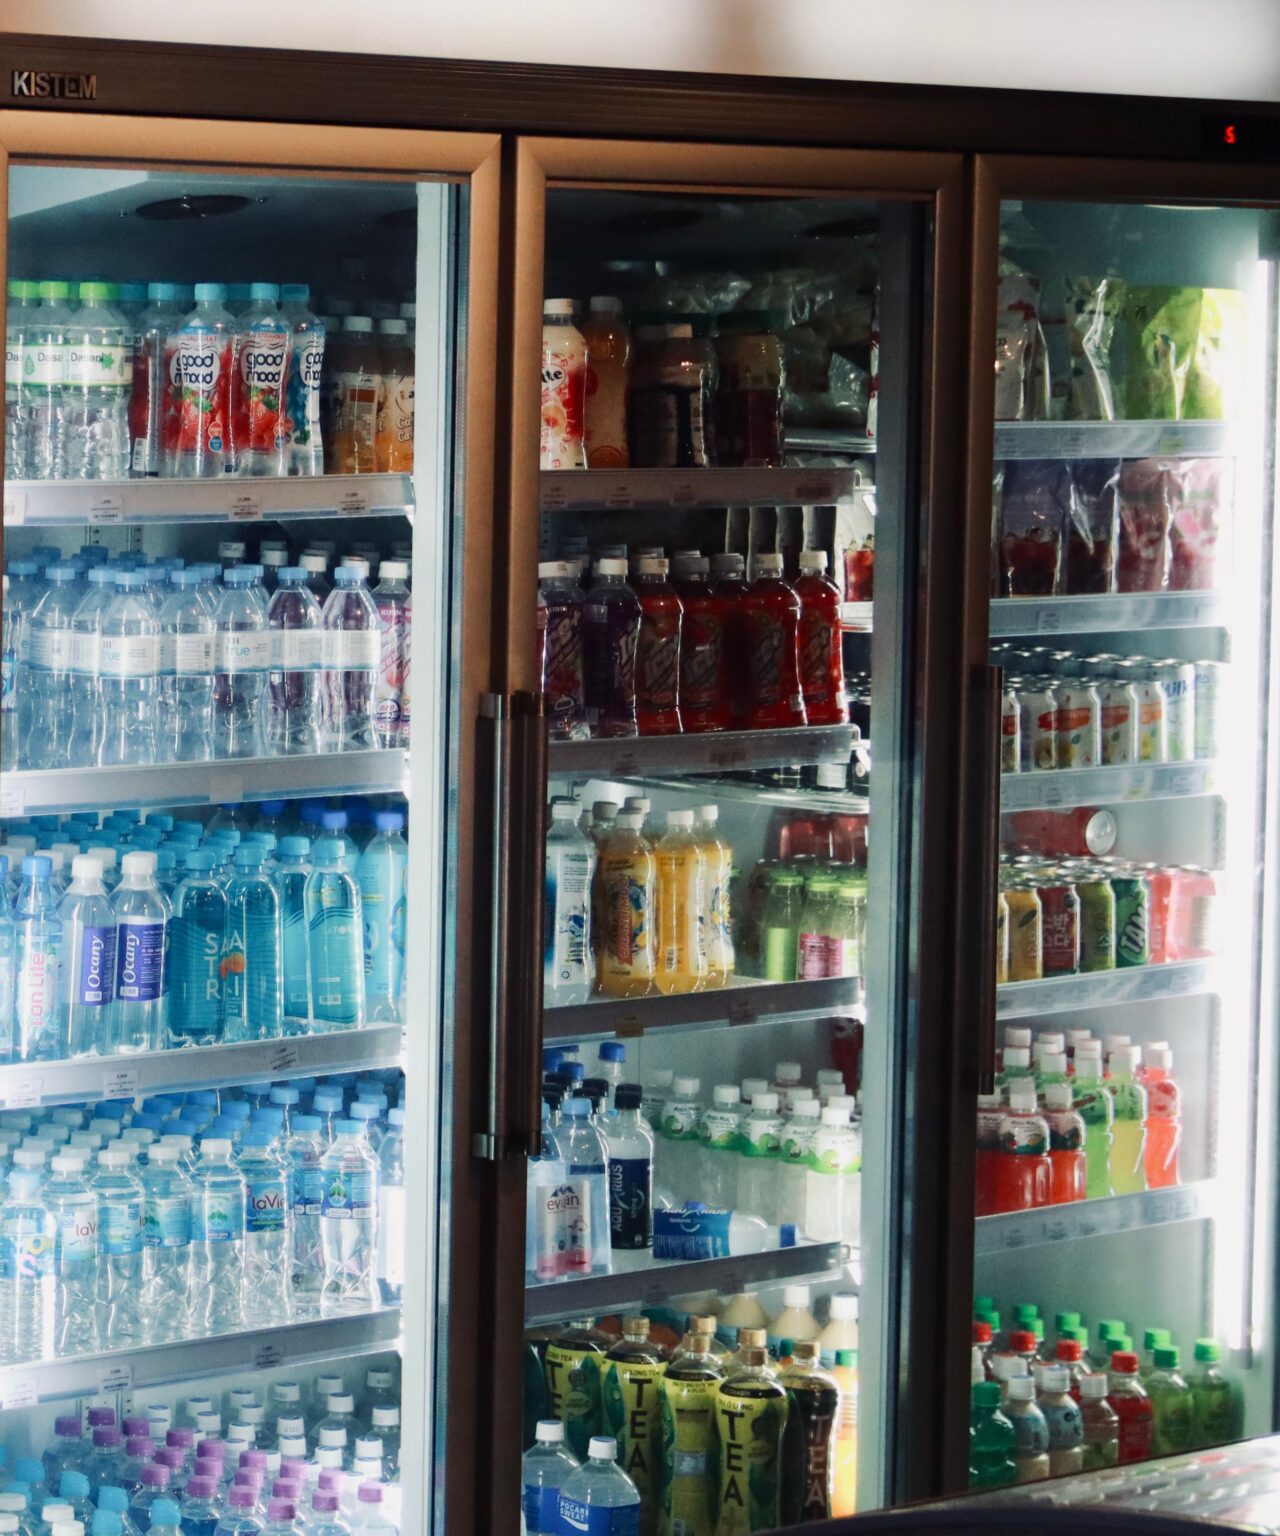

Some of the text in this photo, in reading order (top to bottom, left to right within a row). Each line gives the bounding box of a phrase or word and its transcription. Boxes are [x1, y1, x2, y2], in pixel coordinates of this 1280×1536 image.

[12, 70, 98, 100] KISTEM
[87, 935, 105, 988] Ocany
[123, 931, 140, 984] Ocany
[546, 1194, 580, 1211] evian
[721, 1408, 745, 1508] TEA
[560, 1508, 585, 1523] SWEAT
